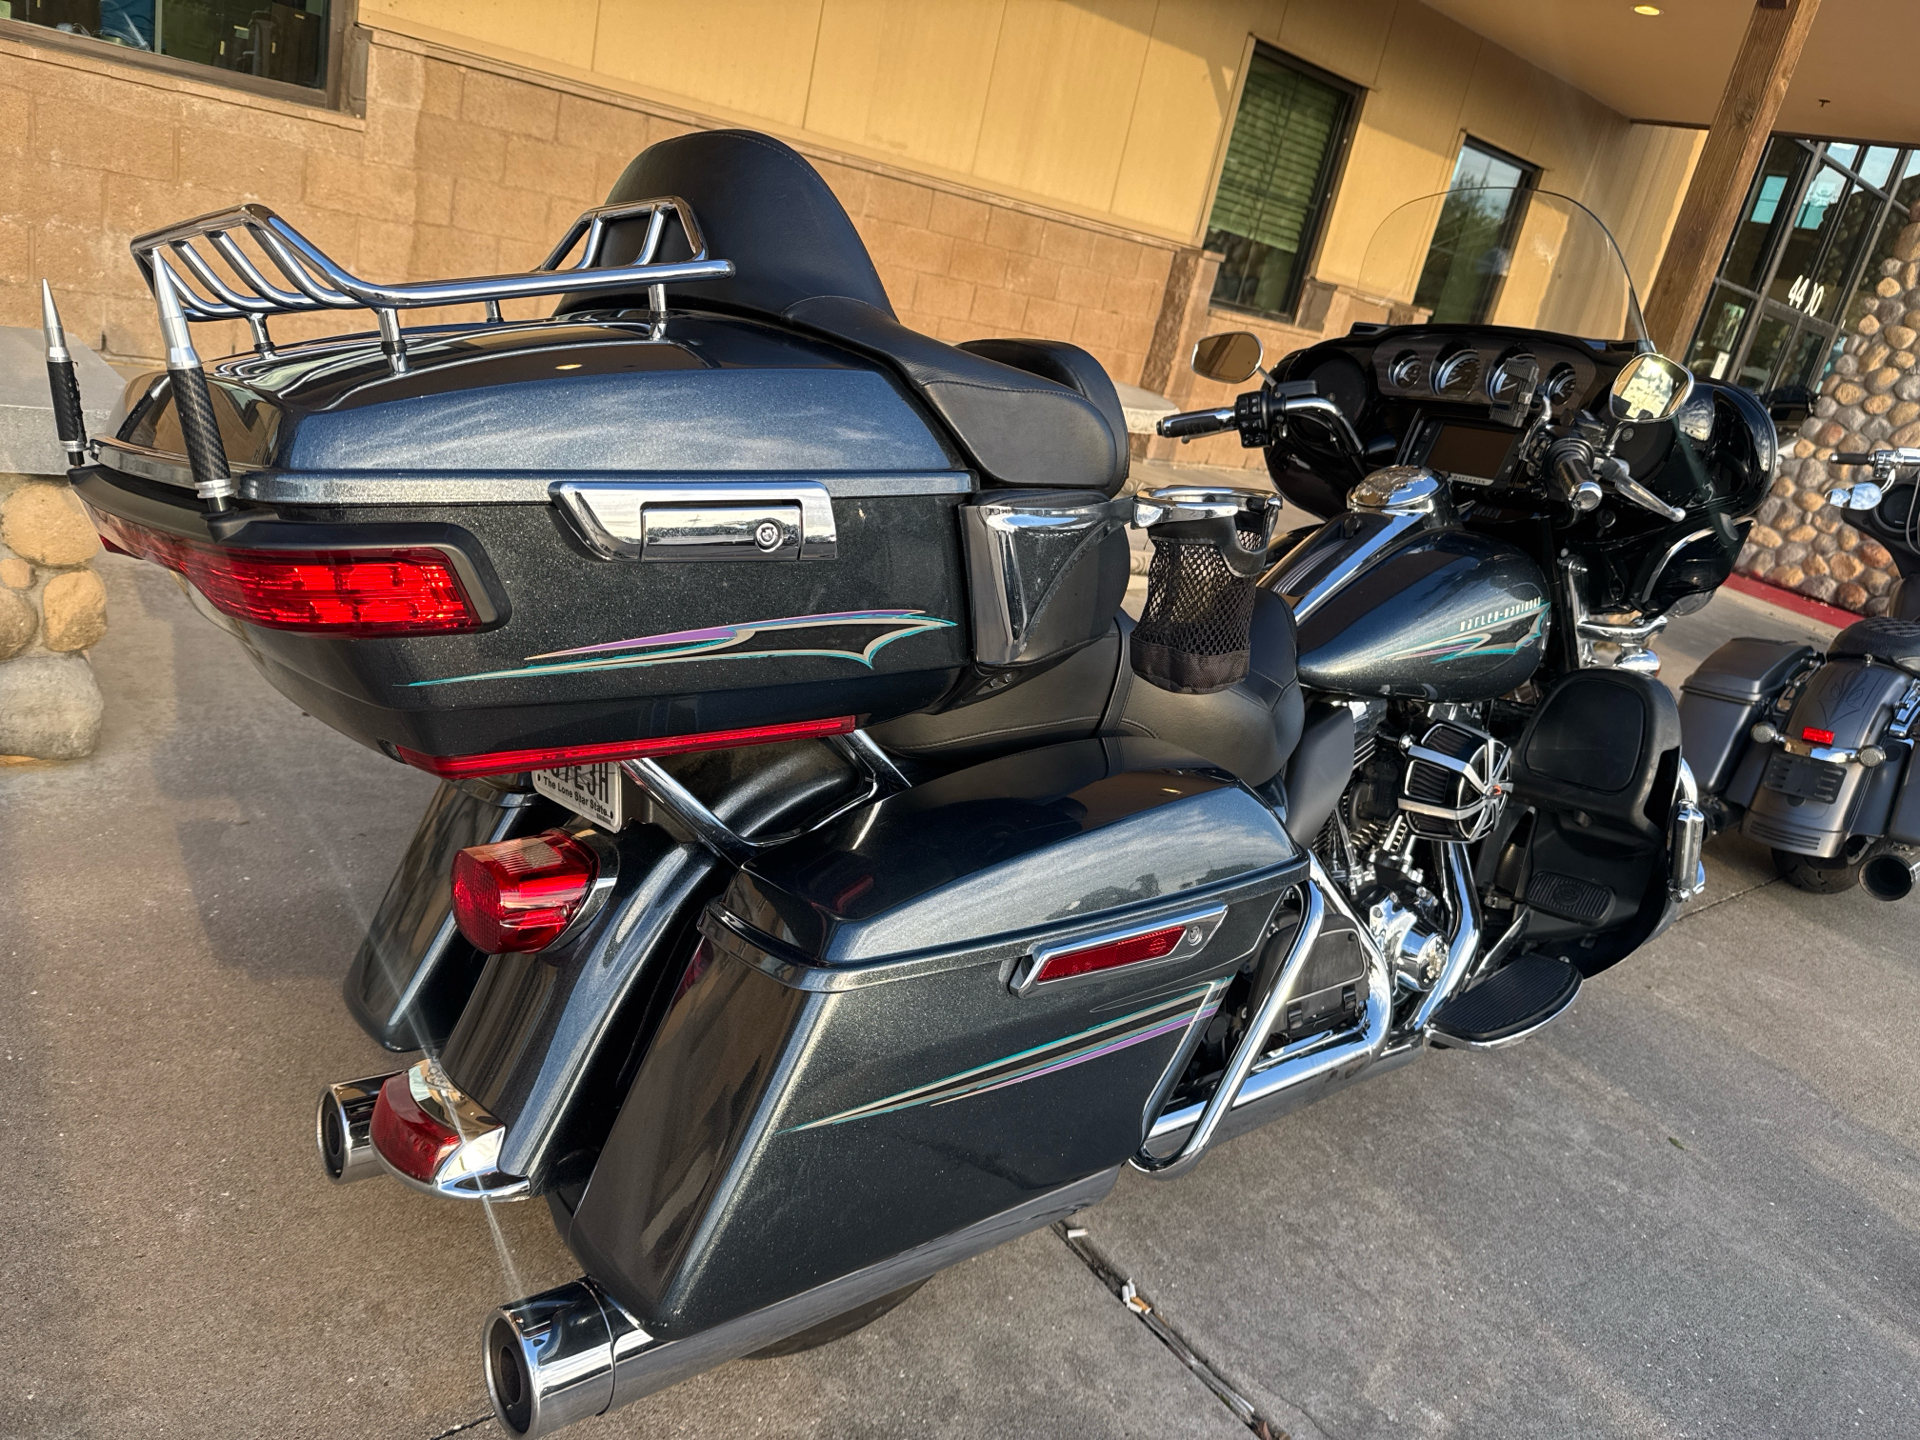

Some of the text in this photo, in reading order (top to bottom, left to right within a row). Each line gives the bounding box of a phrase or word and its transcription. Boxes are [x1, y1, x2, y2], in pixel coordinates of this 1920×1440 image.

[543, 776, 608, 817] The Lone Star State
